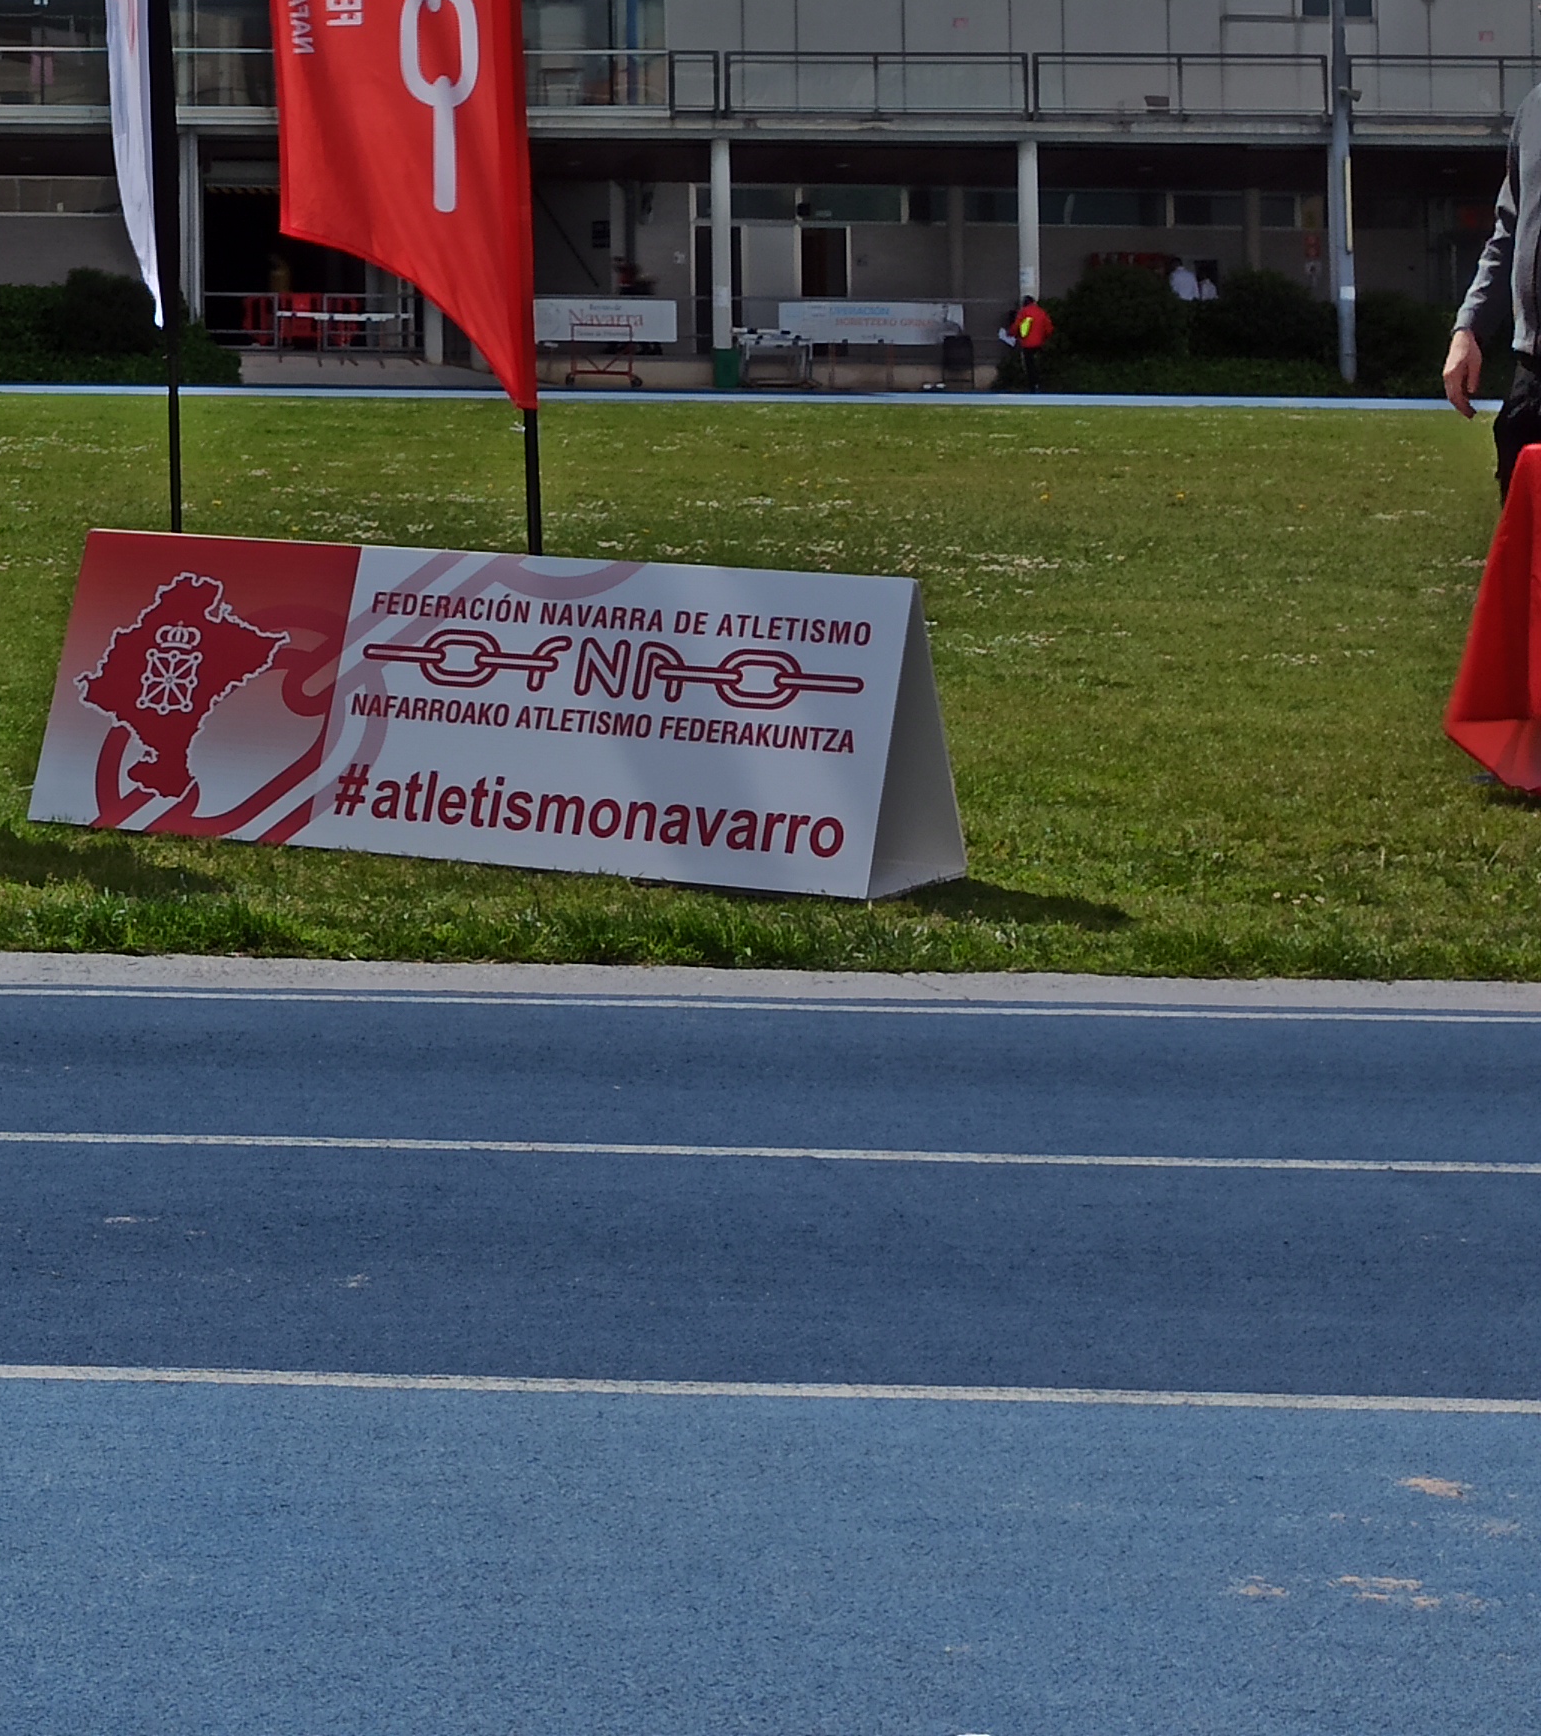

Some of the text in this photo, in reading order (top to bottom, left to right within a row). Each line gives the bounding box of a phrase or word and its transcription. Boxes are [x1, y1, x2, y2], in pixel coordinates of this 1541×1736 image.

[371, 590, 872, 647] FEDERACIÓN NAVARRA DE ATLETISMO
[350, 692, 855, 754] NAFARROAKO ATLETISMO FEDERAKUNTZA
[334, 762, 846, 860] #atletismonavarro
